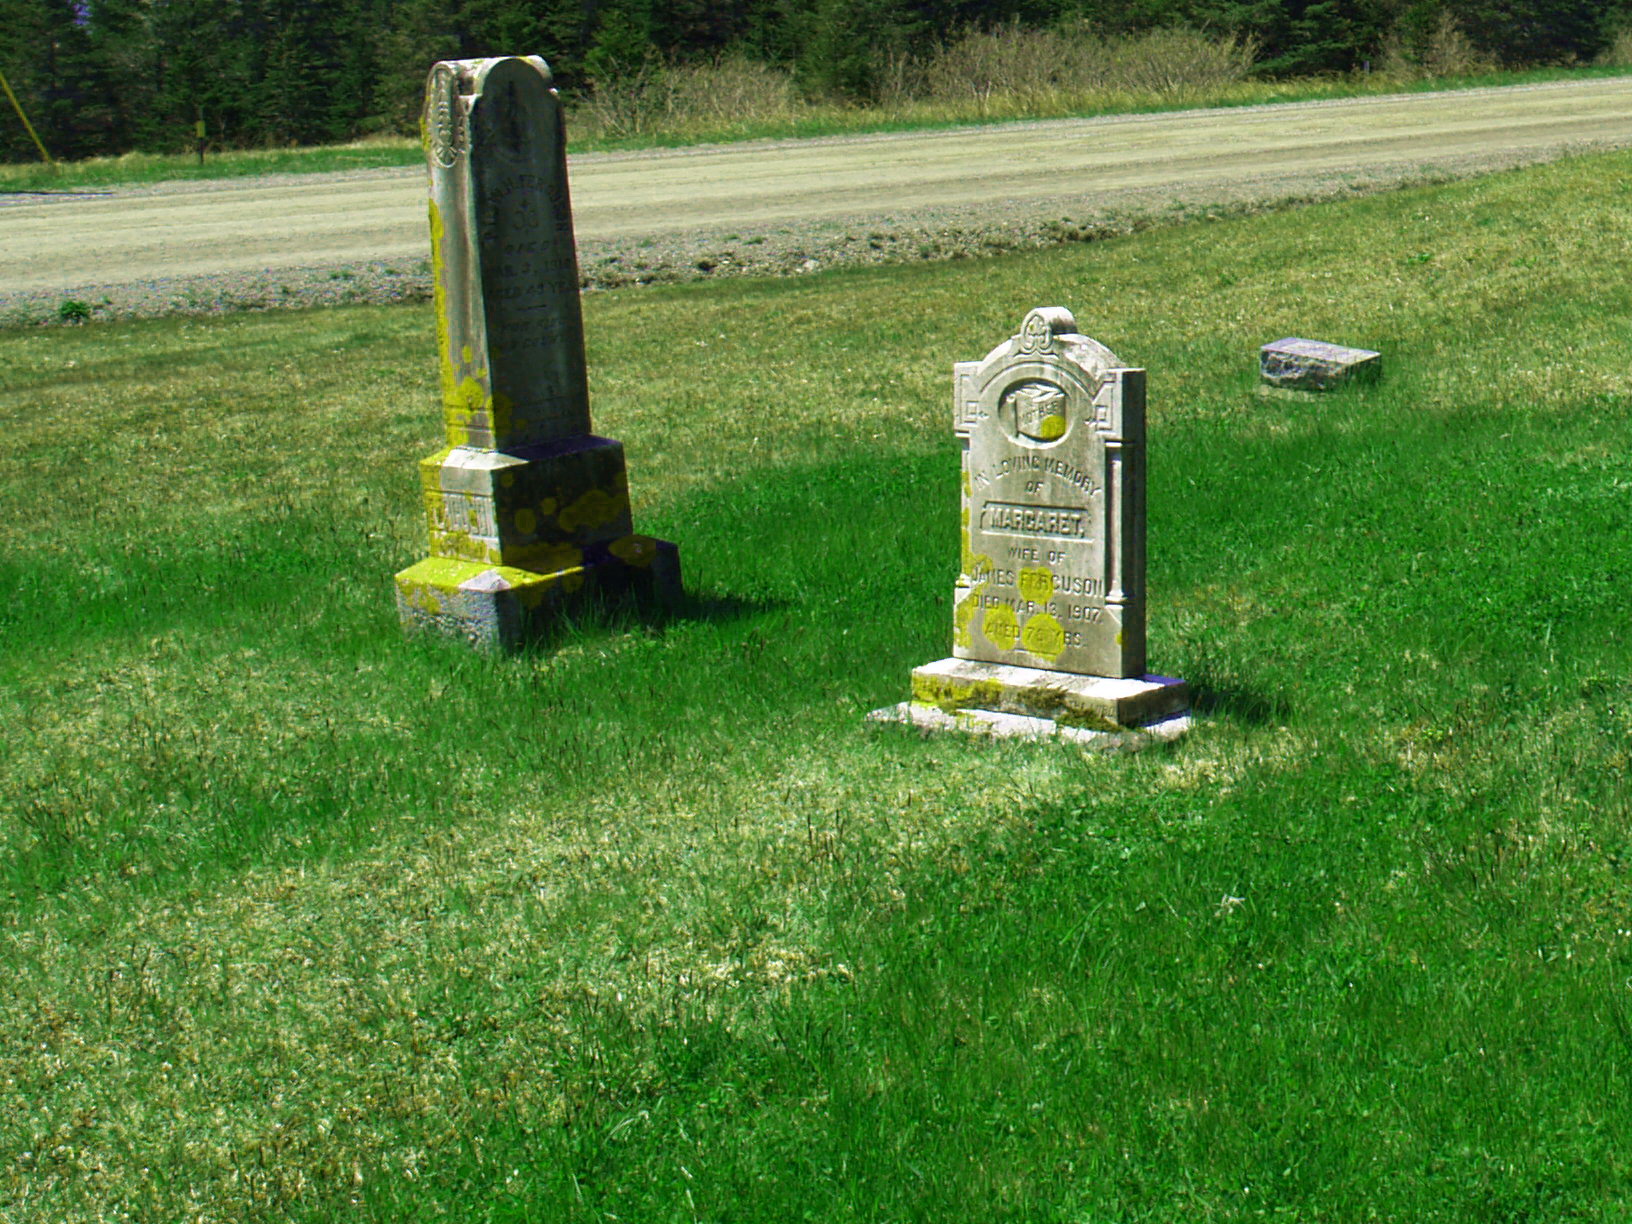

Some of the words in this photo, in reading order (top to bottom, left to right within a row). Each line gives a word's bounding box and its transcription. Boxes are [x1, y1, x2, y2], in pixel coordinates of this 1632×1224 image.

[1044, 456, 1103, 496] MEMORY
[1025, 480, 1045, 495] OF
[1008, 546, 1040, 563] WIFE
[1048, 550, 1067, 565] OF
[971, 566, 1015, 586] JAMES
[972, 594, 1000, 610] DIED
